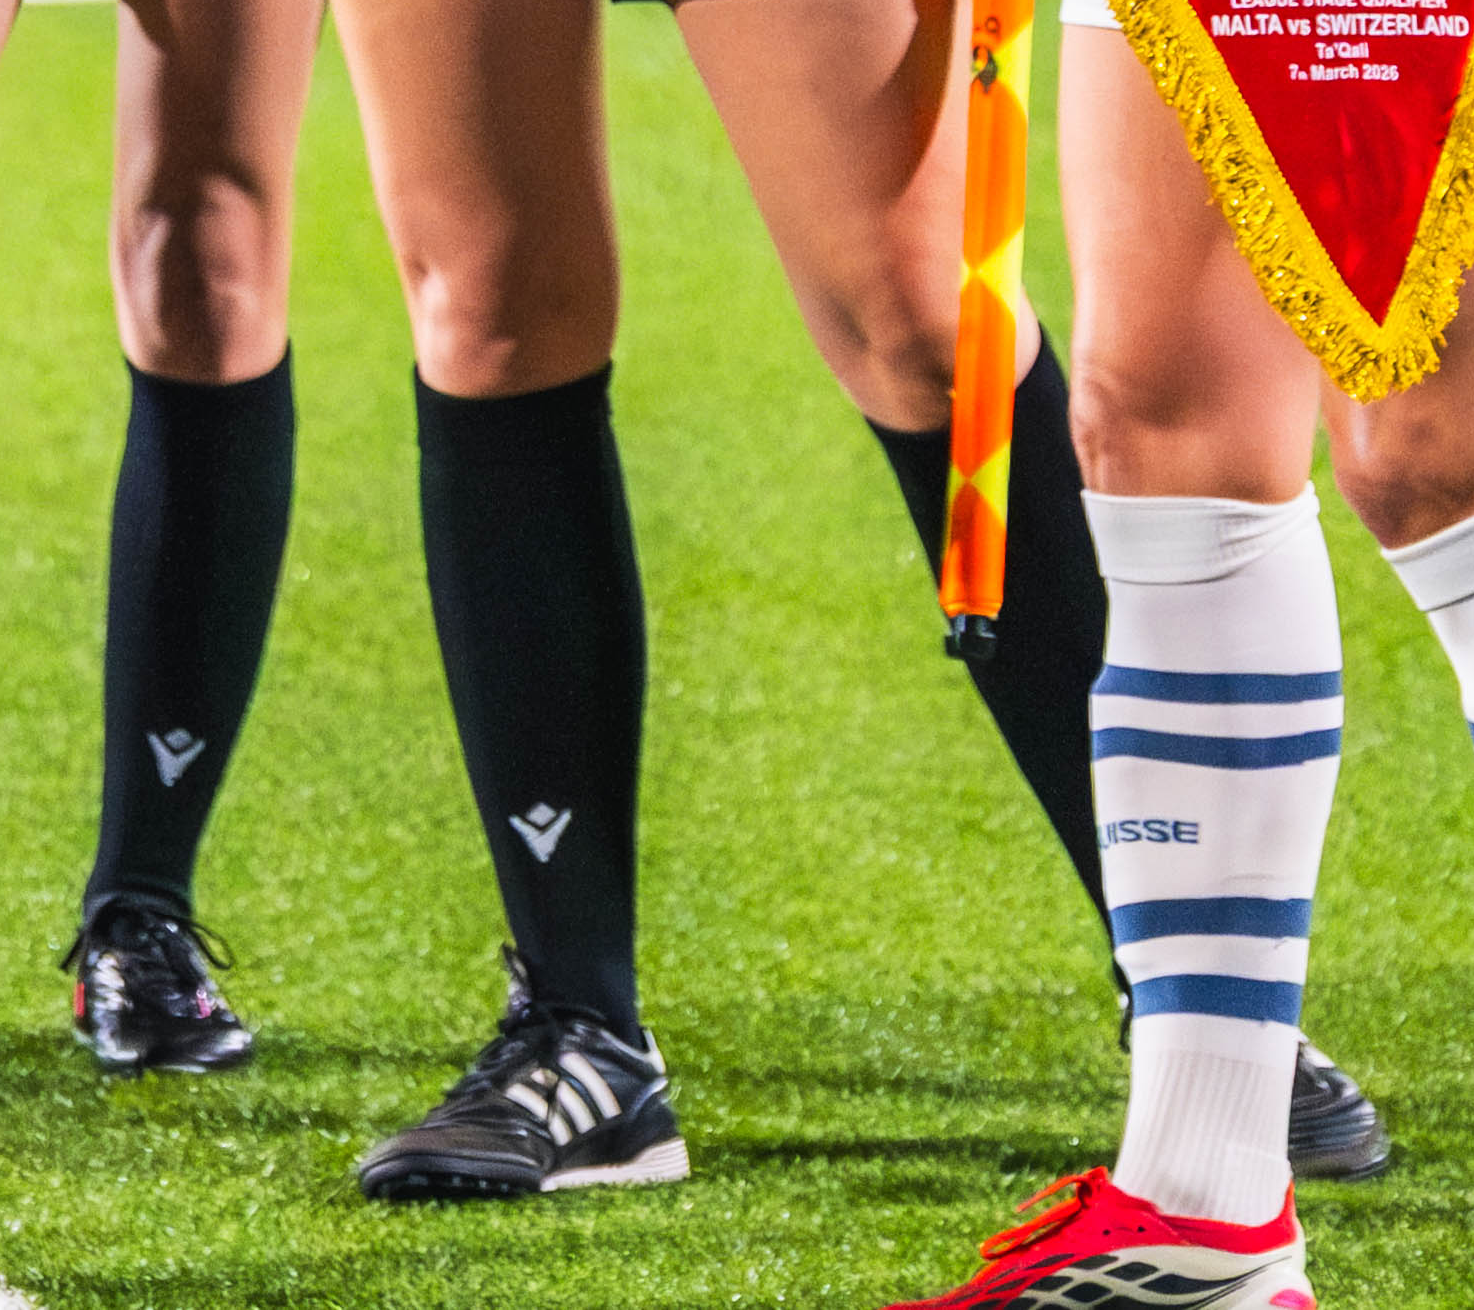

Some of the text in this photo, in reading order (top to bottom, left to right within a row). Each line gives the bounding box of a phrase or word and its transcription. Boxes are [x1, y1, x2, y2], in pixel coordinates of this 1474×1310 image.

[1210, 14, 1470, 37] MALTA vs SWITZERLAND
[1310, 64, 1360, 81] March
[1362, 64, 1400, 81] 2026
